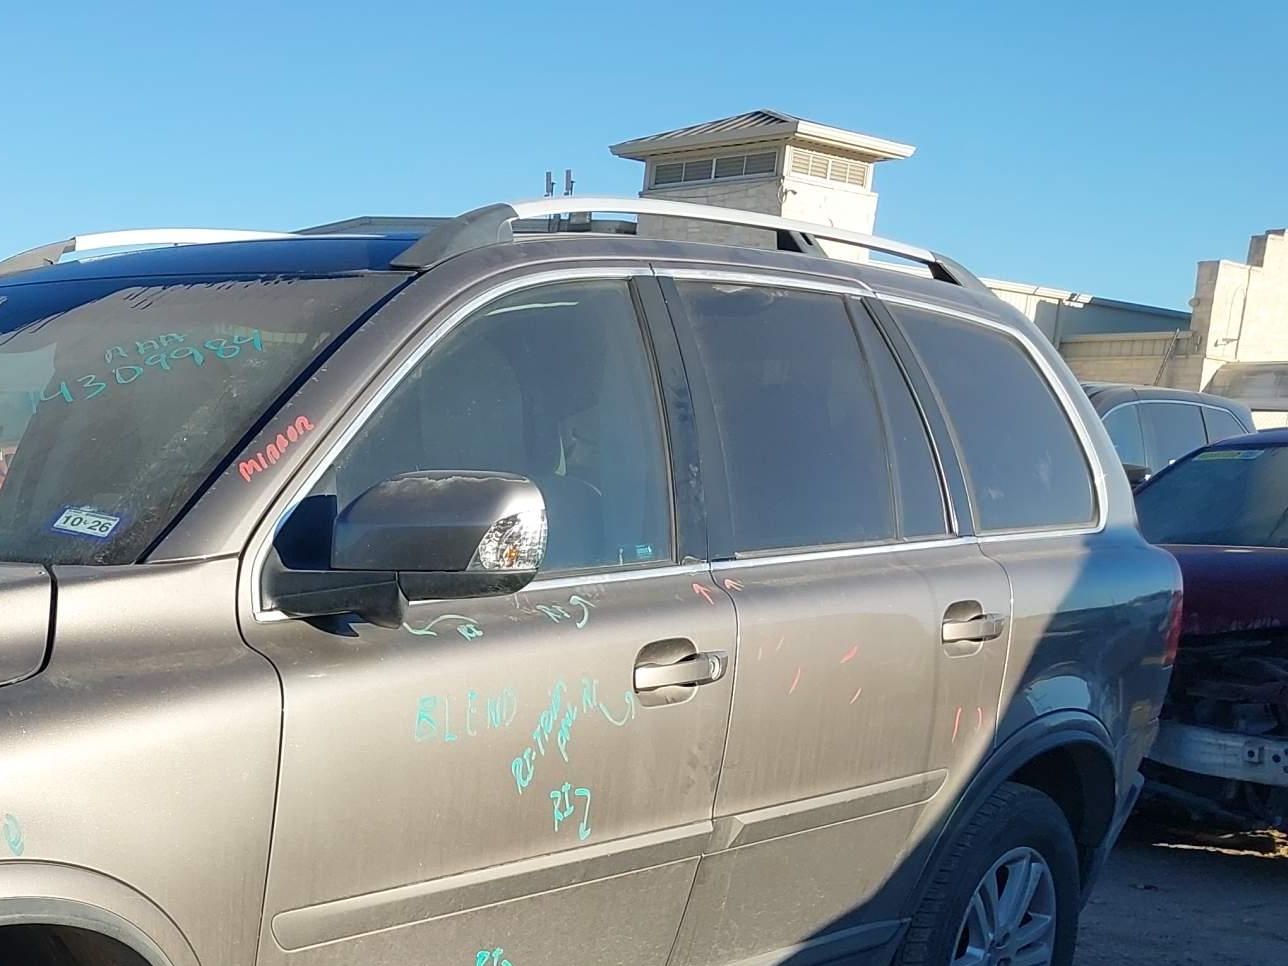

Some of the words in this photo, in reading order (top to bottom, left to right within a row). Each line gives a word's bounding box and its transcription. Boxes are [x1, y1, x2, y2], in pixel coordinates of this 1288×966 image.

[62, 515, 84, 528] 10
[86, 520, 112, 533] 26
[414, 686, 518, 742] BLEND
